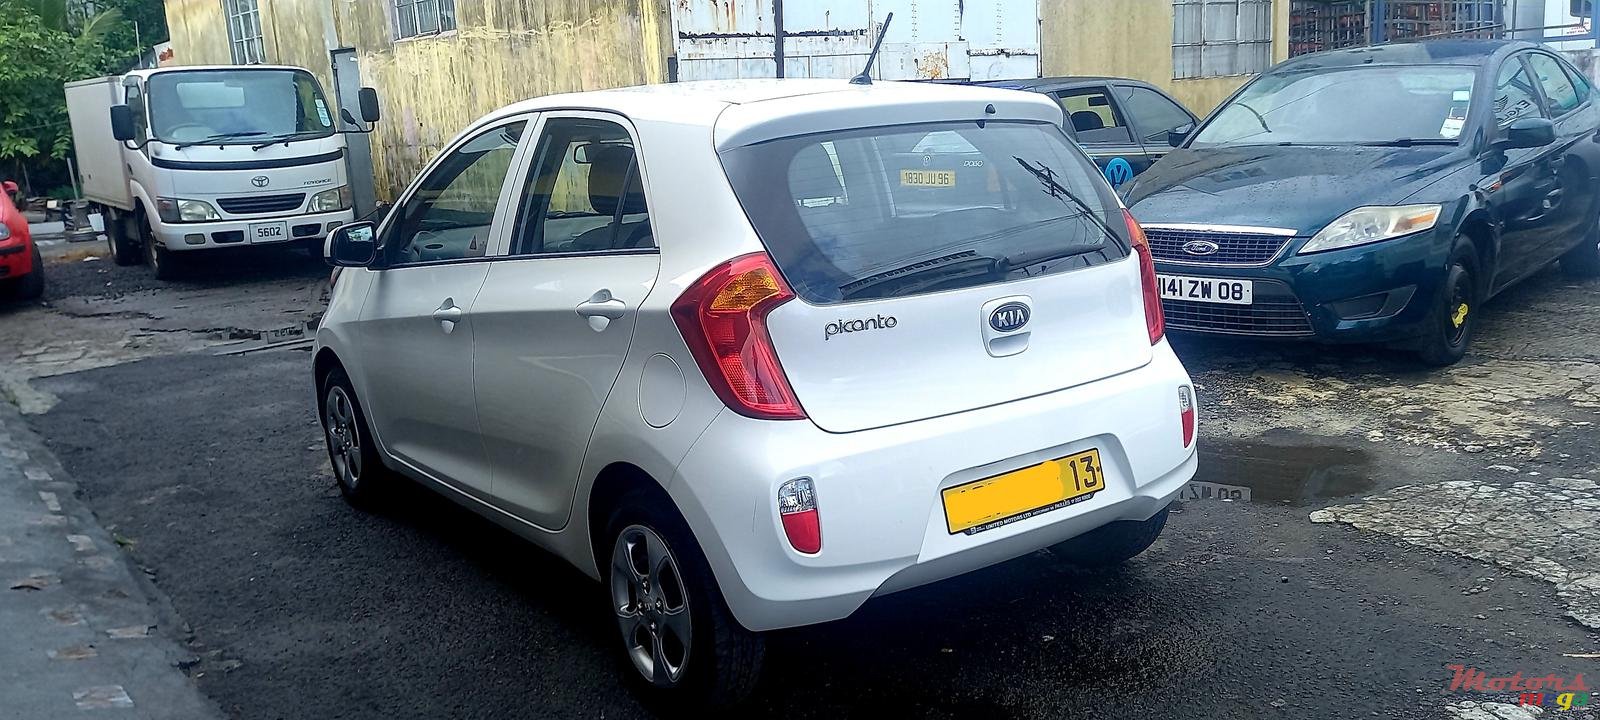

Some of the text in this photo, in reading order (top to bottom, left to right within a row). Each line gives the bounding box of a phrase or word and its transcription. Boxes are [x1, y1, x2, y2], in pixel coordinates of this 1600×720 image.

[905, 172, 949, 184] 1830 JU 96
[257, 226, 282, 237] 5602
[1188, 280, 1212, 298] ZW
[1218, 282, 1243, 300] 08
[824, 314, 898, 341] picanto
[996, 308, 1026, 328] KIA
[1069, 455, 1098, 491] 13
[985, 521, 1004, 530] UNITED
[1003, 514, 1023, 524] MOTORS
